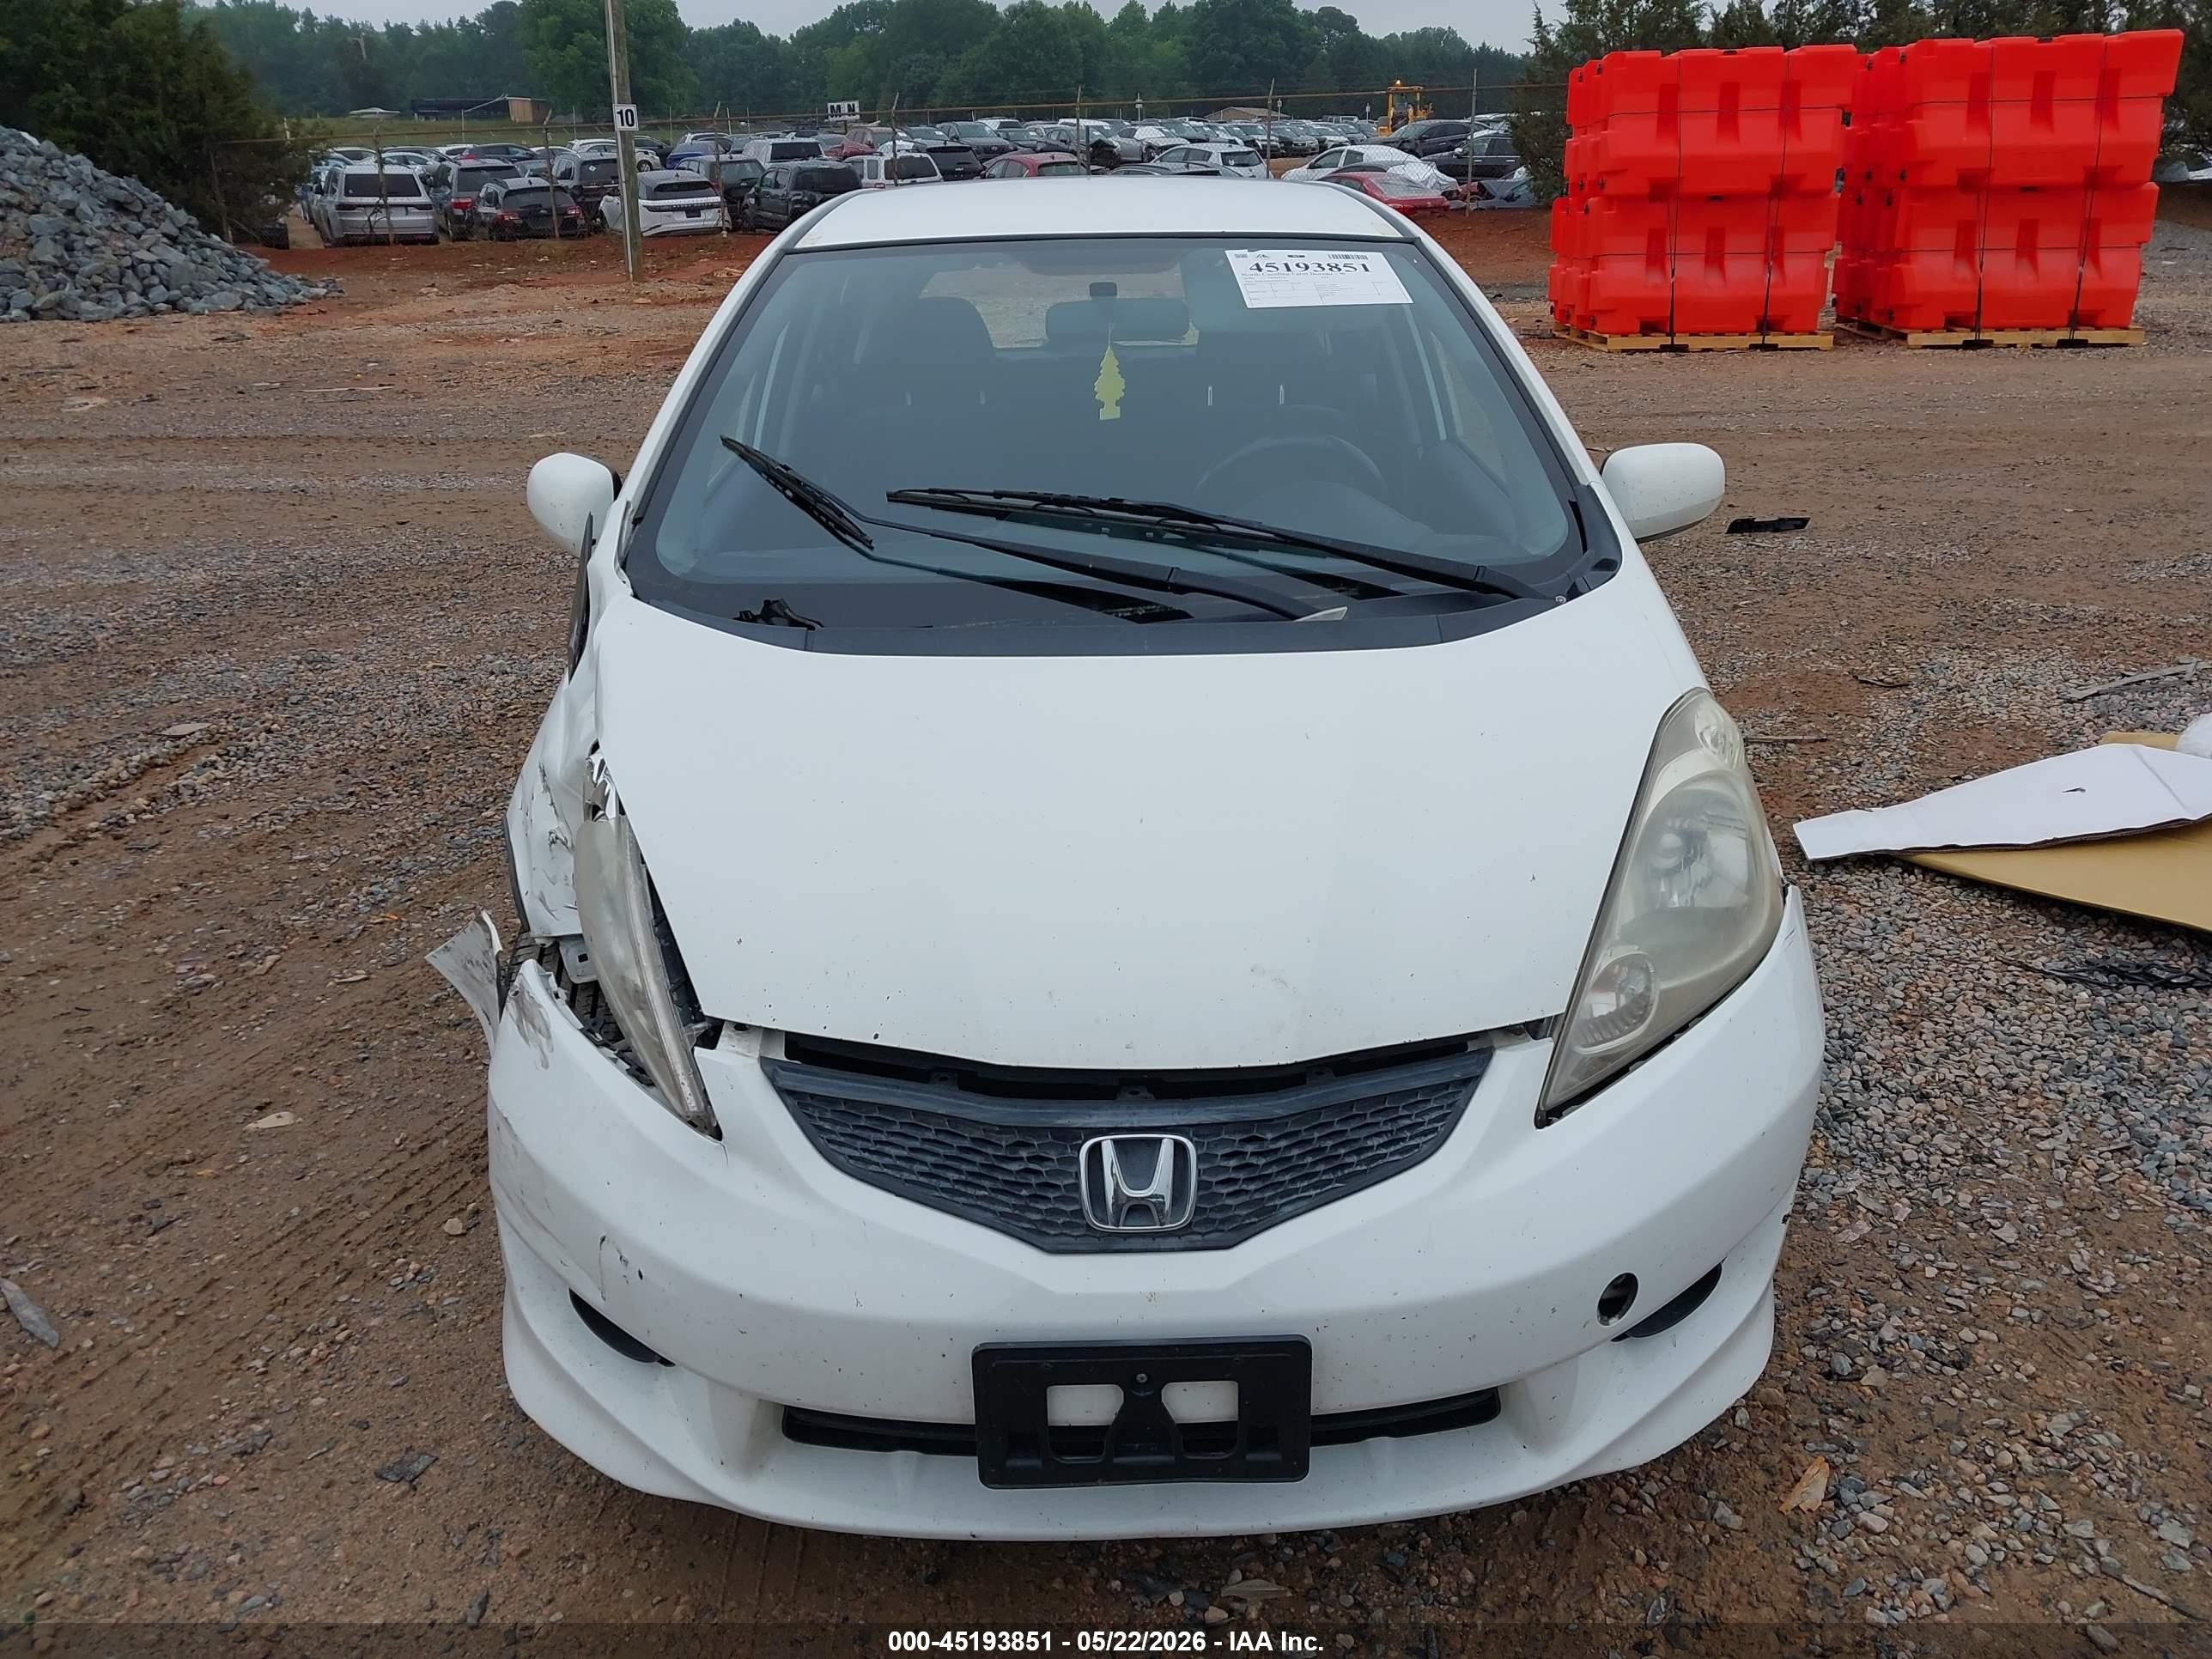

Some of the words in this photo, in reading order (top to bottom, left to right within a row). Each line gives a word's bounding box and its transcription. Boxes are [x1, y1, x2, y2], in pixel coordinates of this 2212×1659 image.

[617, 108, 635, 127] 10
[830, 104, 842, 118] M
[1249, 261, 1372, 273] 45193851
